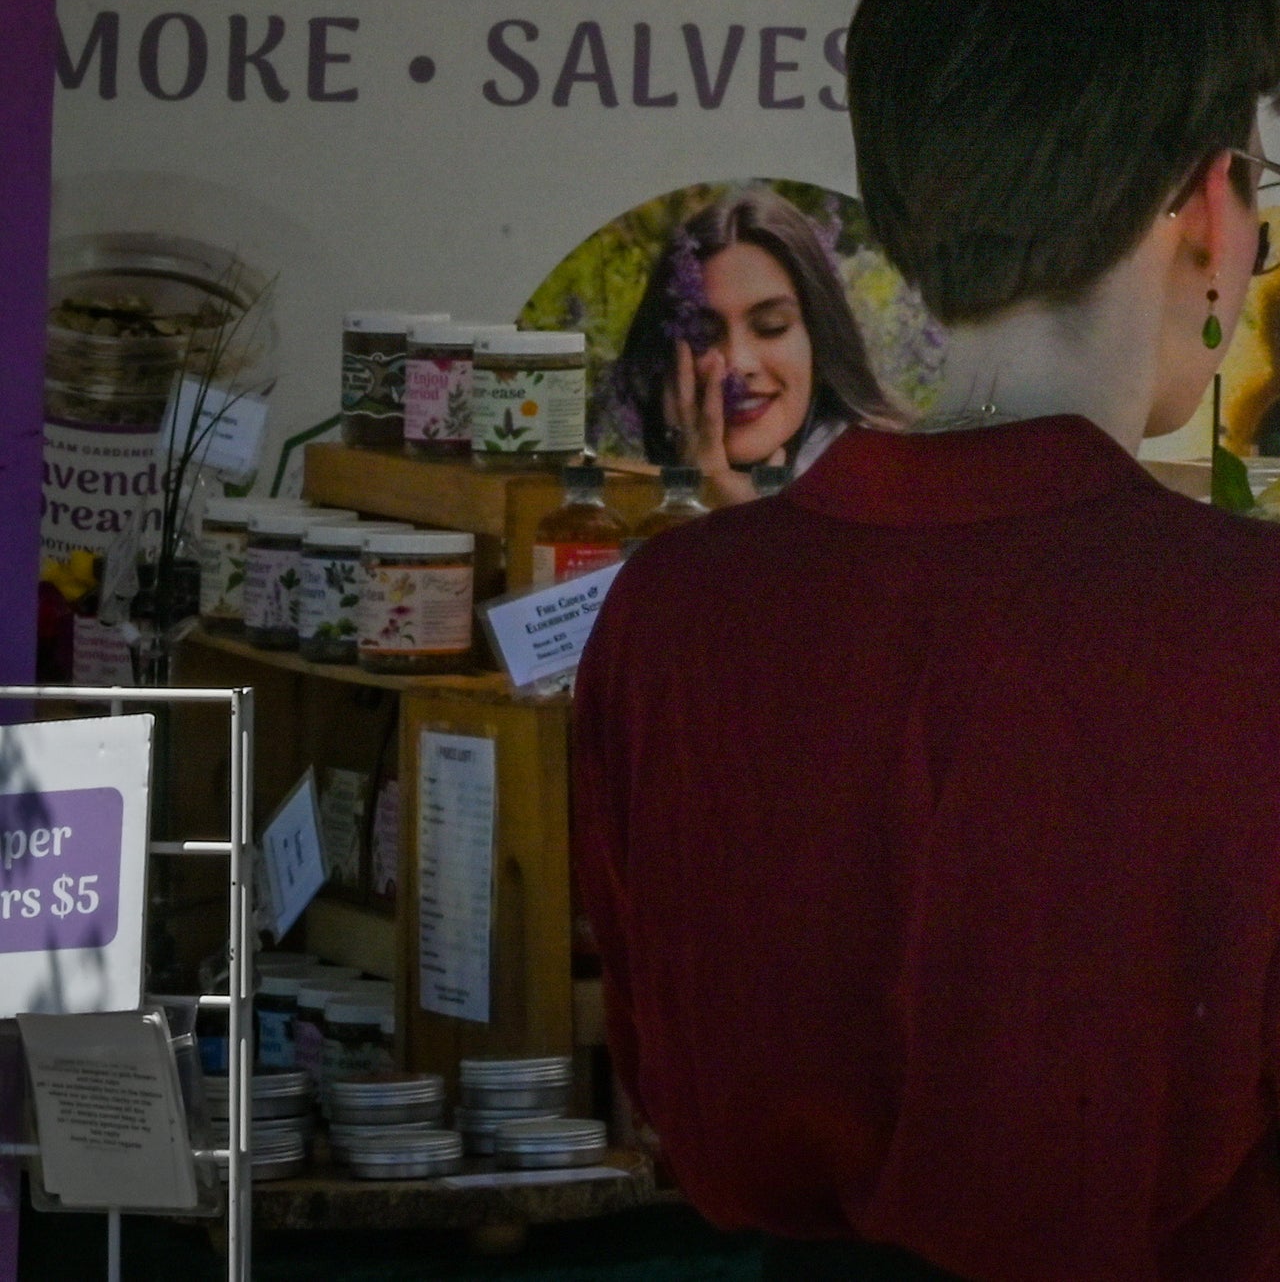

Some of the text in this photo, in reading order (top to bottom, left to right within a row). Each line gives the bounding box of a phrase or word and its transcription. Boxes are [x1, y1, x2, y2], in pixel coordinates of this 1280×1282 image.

[53, 11, 850, 112] MOKE SALVES
[0, 825, 73, 870] per
[0, 873, 99, 921] rs $5
